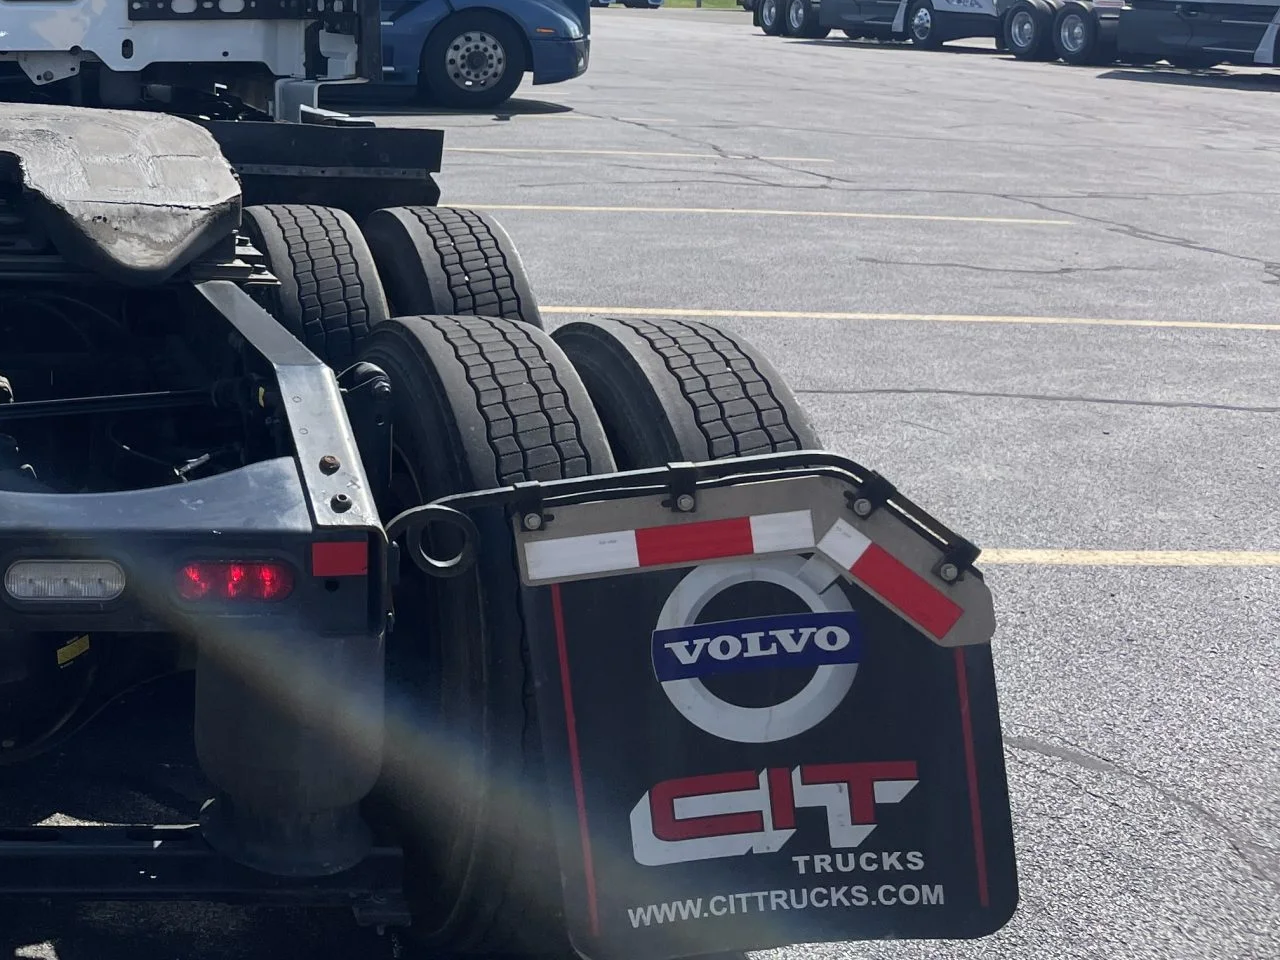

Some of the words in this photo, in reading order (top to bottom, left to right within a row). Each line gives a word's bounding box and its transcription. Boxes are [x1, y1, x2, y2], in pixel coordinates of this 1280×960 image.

[665, 625, 851, 665] VOLVO
[630, 761, 920, 866] CIT
[793, 852, 925, 874] TRUCKS
[628, 885, 945, 928] WWW.CITTRUCKS.COM
